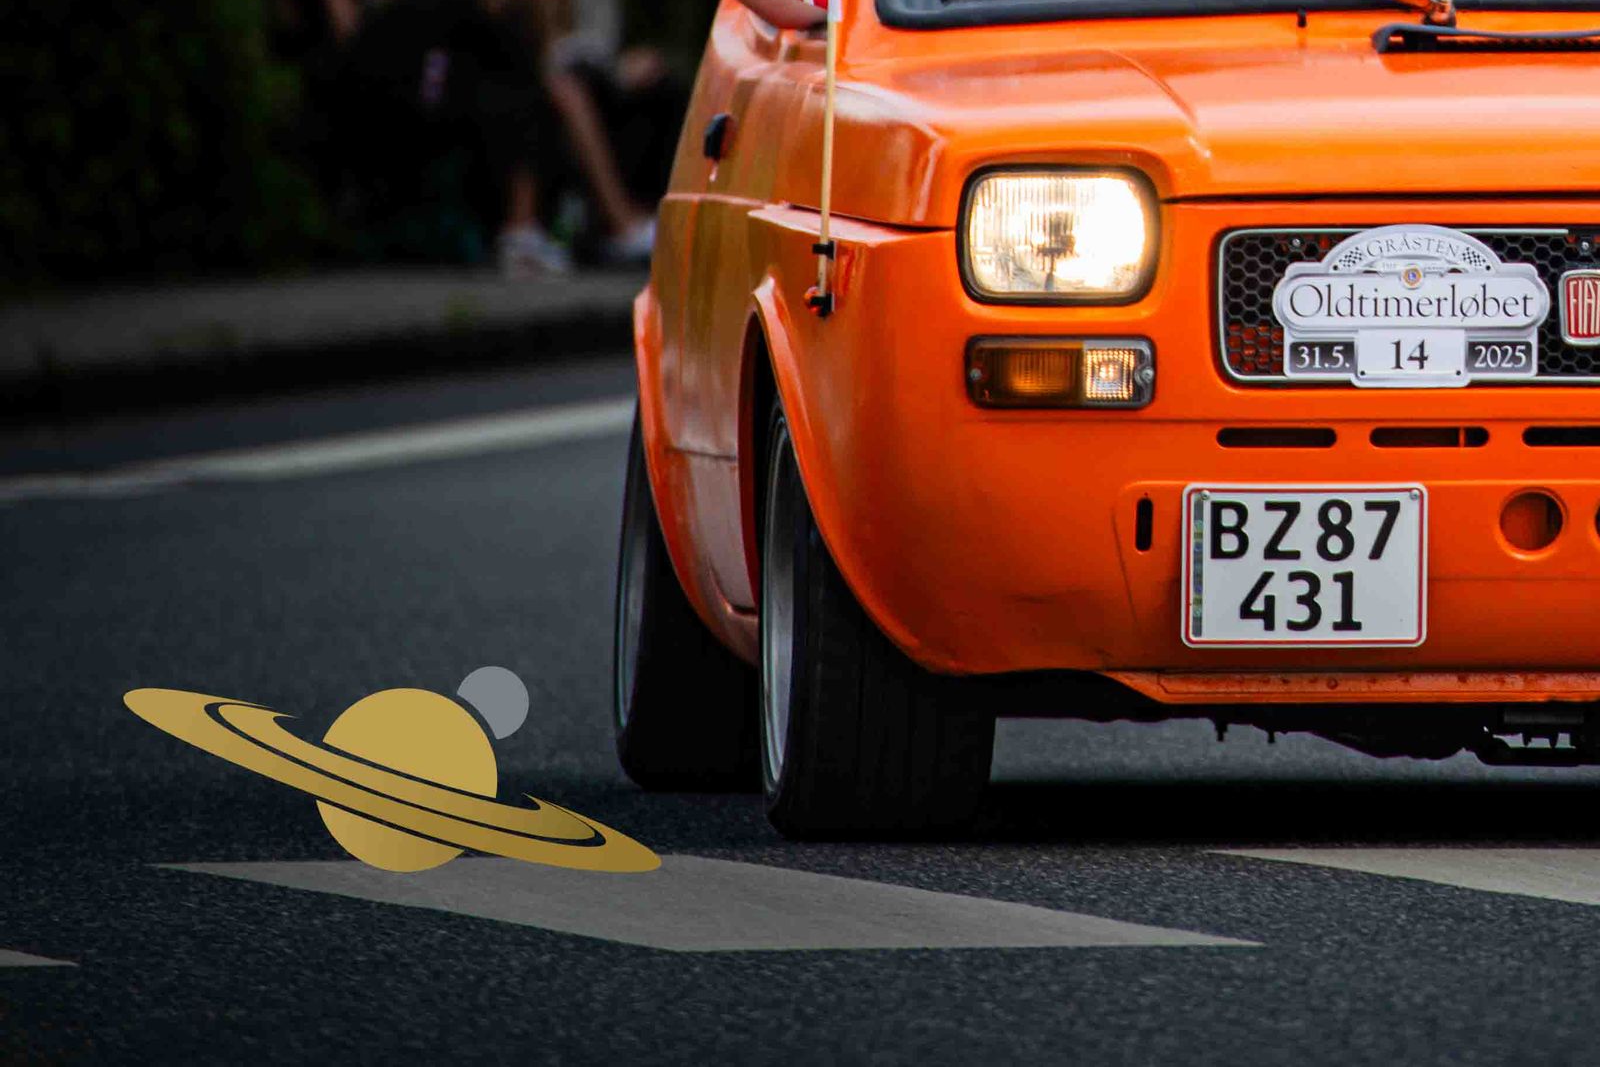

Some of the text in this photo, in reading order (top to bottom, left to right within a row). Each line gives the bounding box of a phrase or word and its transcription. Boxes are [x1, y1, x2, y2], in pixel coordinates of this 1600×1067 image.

[1366, 233, 1459, 258] GRÅSTEN
[1289, 283, 1534, 322] Oldtimerløbet
[1296, 346, 1350, 368] 31.5.
[1391, 338, 1429, 370] 14
[1474, 345, 1527, 368] 2025
[1210, 499, 1401, 561] BZ87
[1239, 571, 1362, 631] 431
